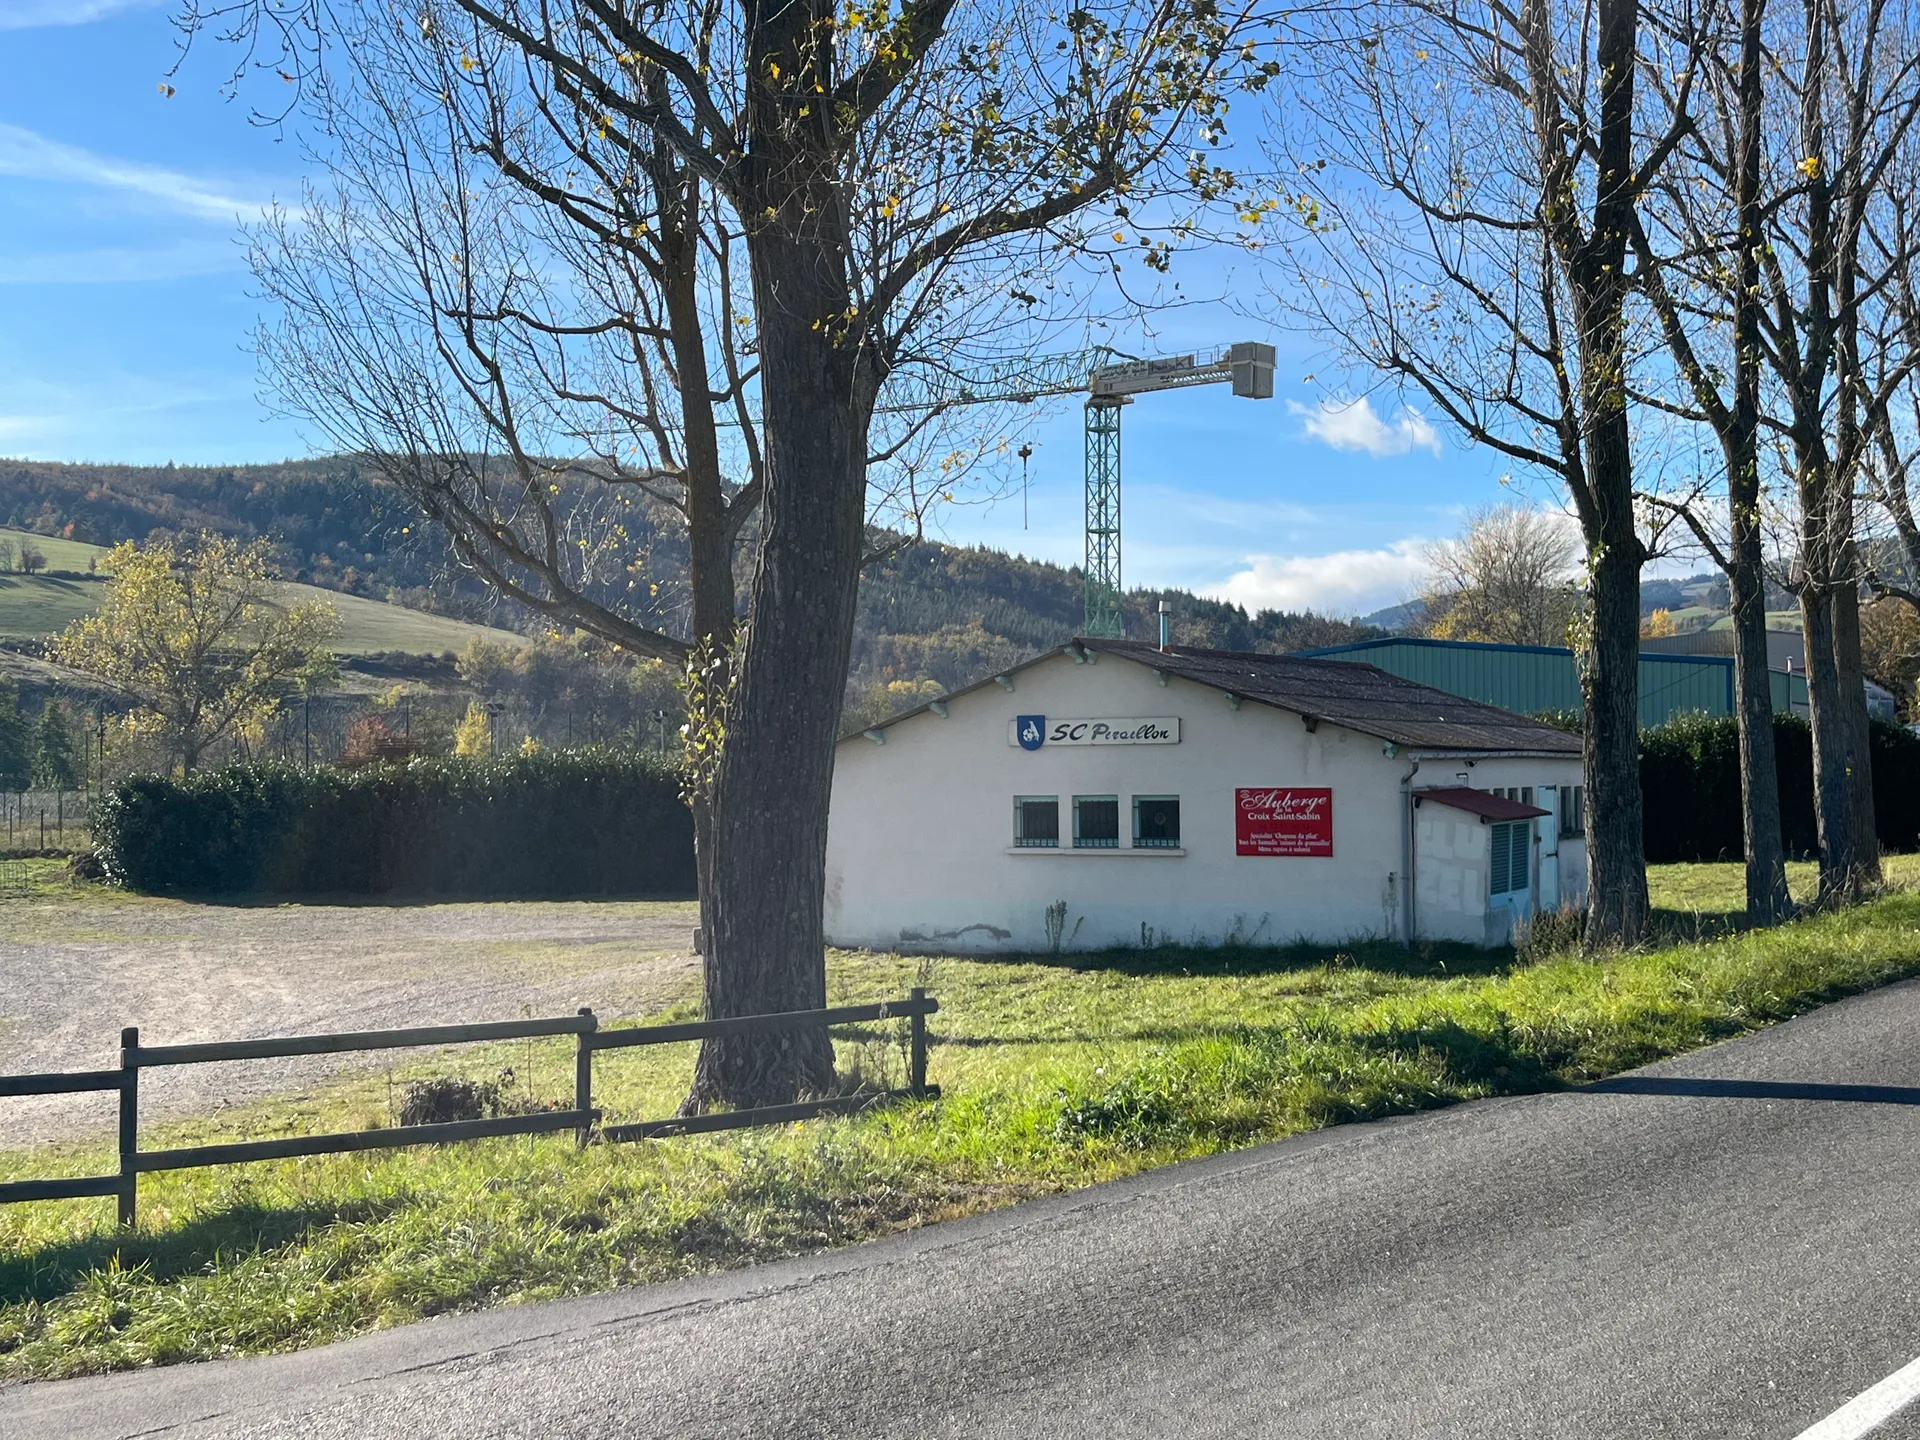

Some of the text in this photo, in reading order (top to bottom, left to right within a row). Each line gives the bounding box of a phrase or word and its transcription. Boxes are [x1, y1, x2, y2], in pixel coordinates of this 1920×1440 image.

[1050, 723, 1088, 741] SC
[1241, 790, 1327, 813] Auberge
[1248, 812, 1270, 820] Croix
